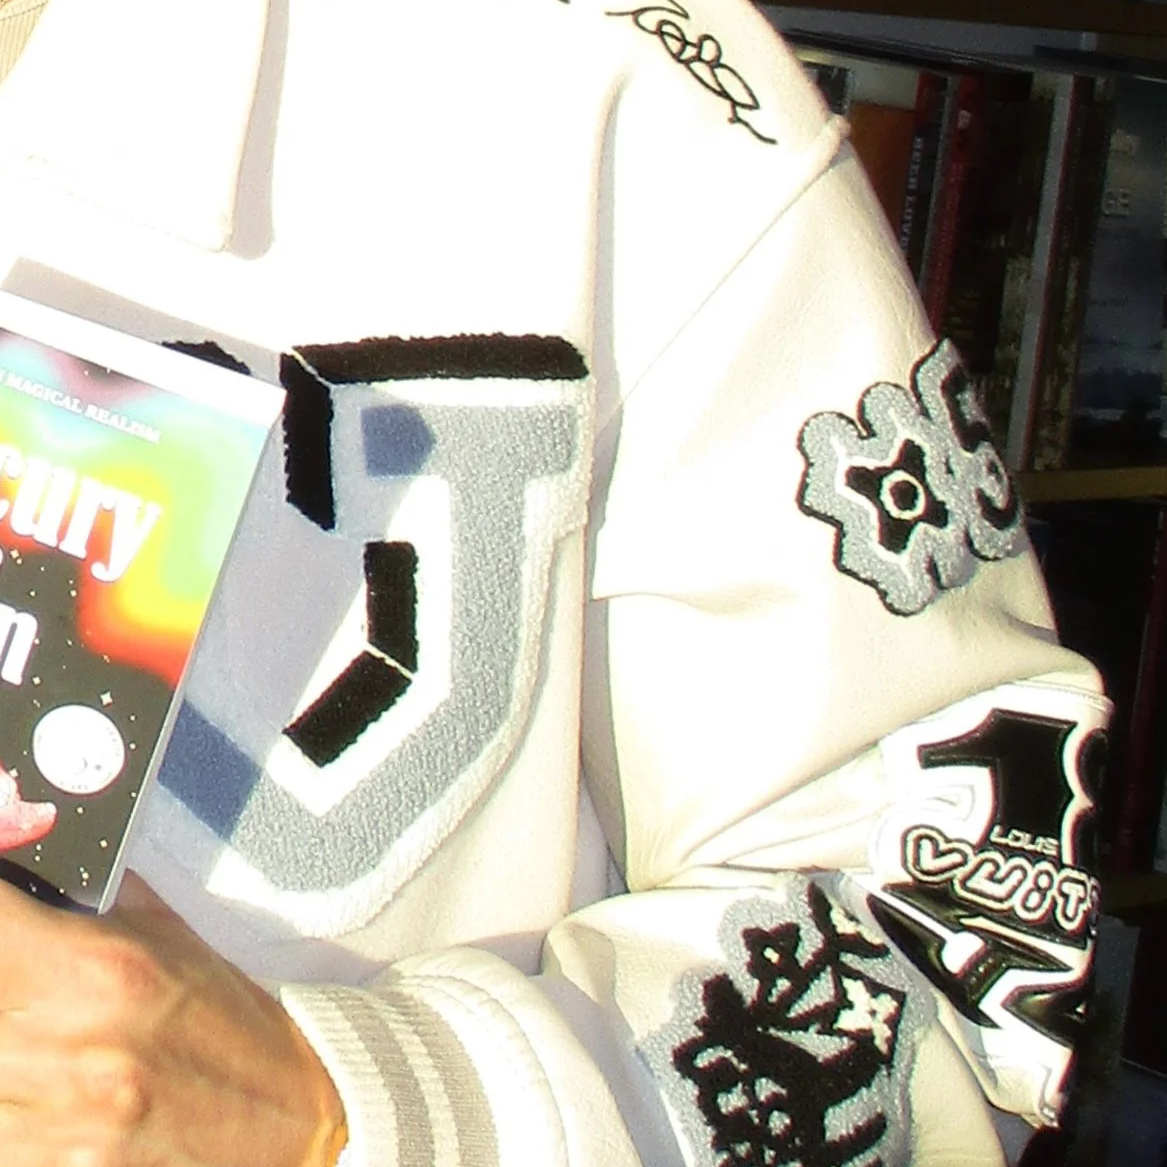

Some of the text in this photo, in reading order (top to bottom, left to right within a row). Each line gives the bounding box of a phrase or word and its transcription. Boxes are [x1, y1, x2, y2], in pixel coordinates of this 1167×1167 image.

[905, 136, 925, 190] BEER
[6, 370, 84, 416] MAGICAL
[989, 824, 1061, 858] LOUIS
